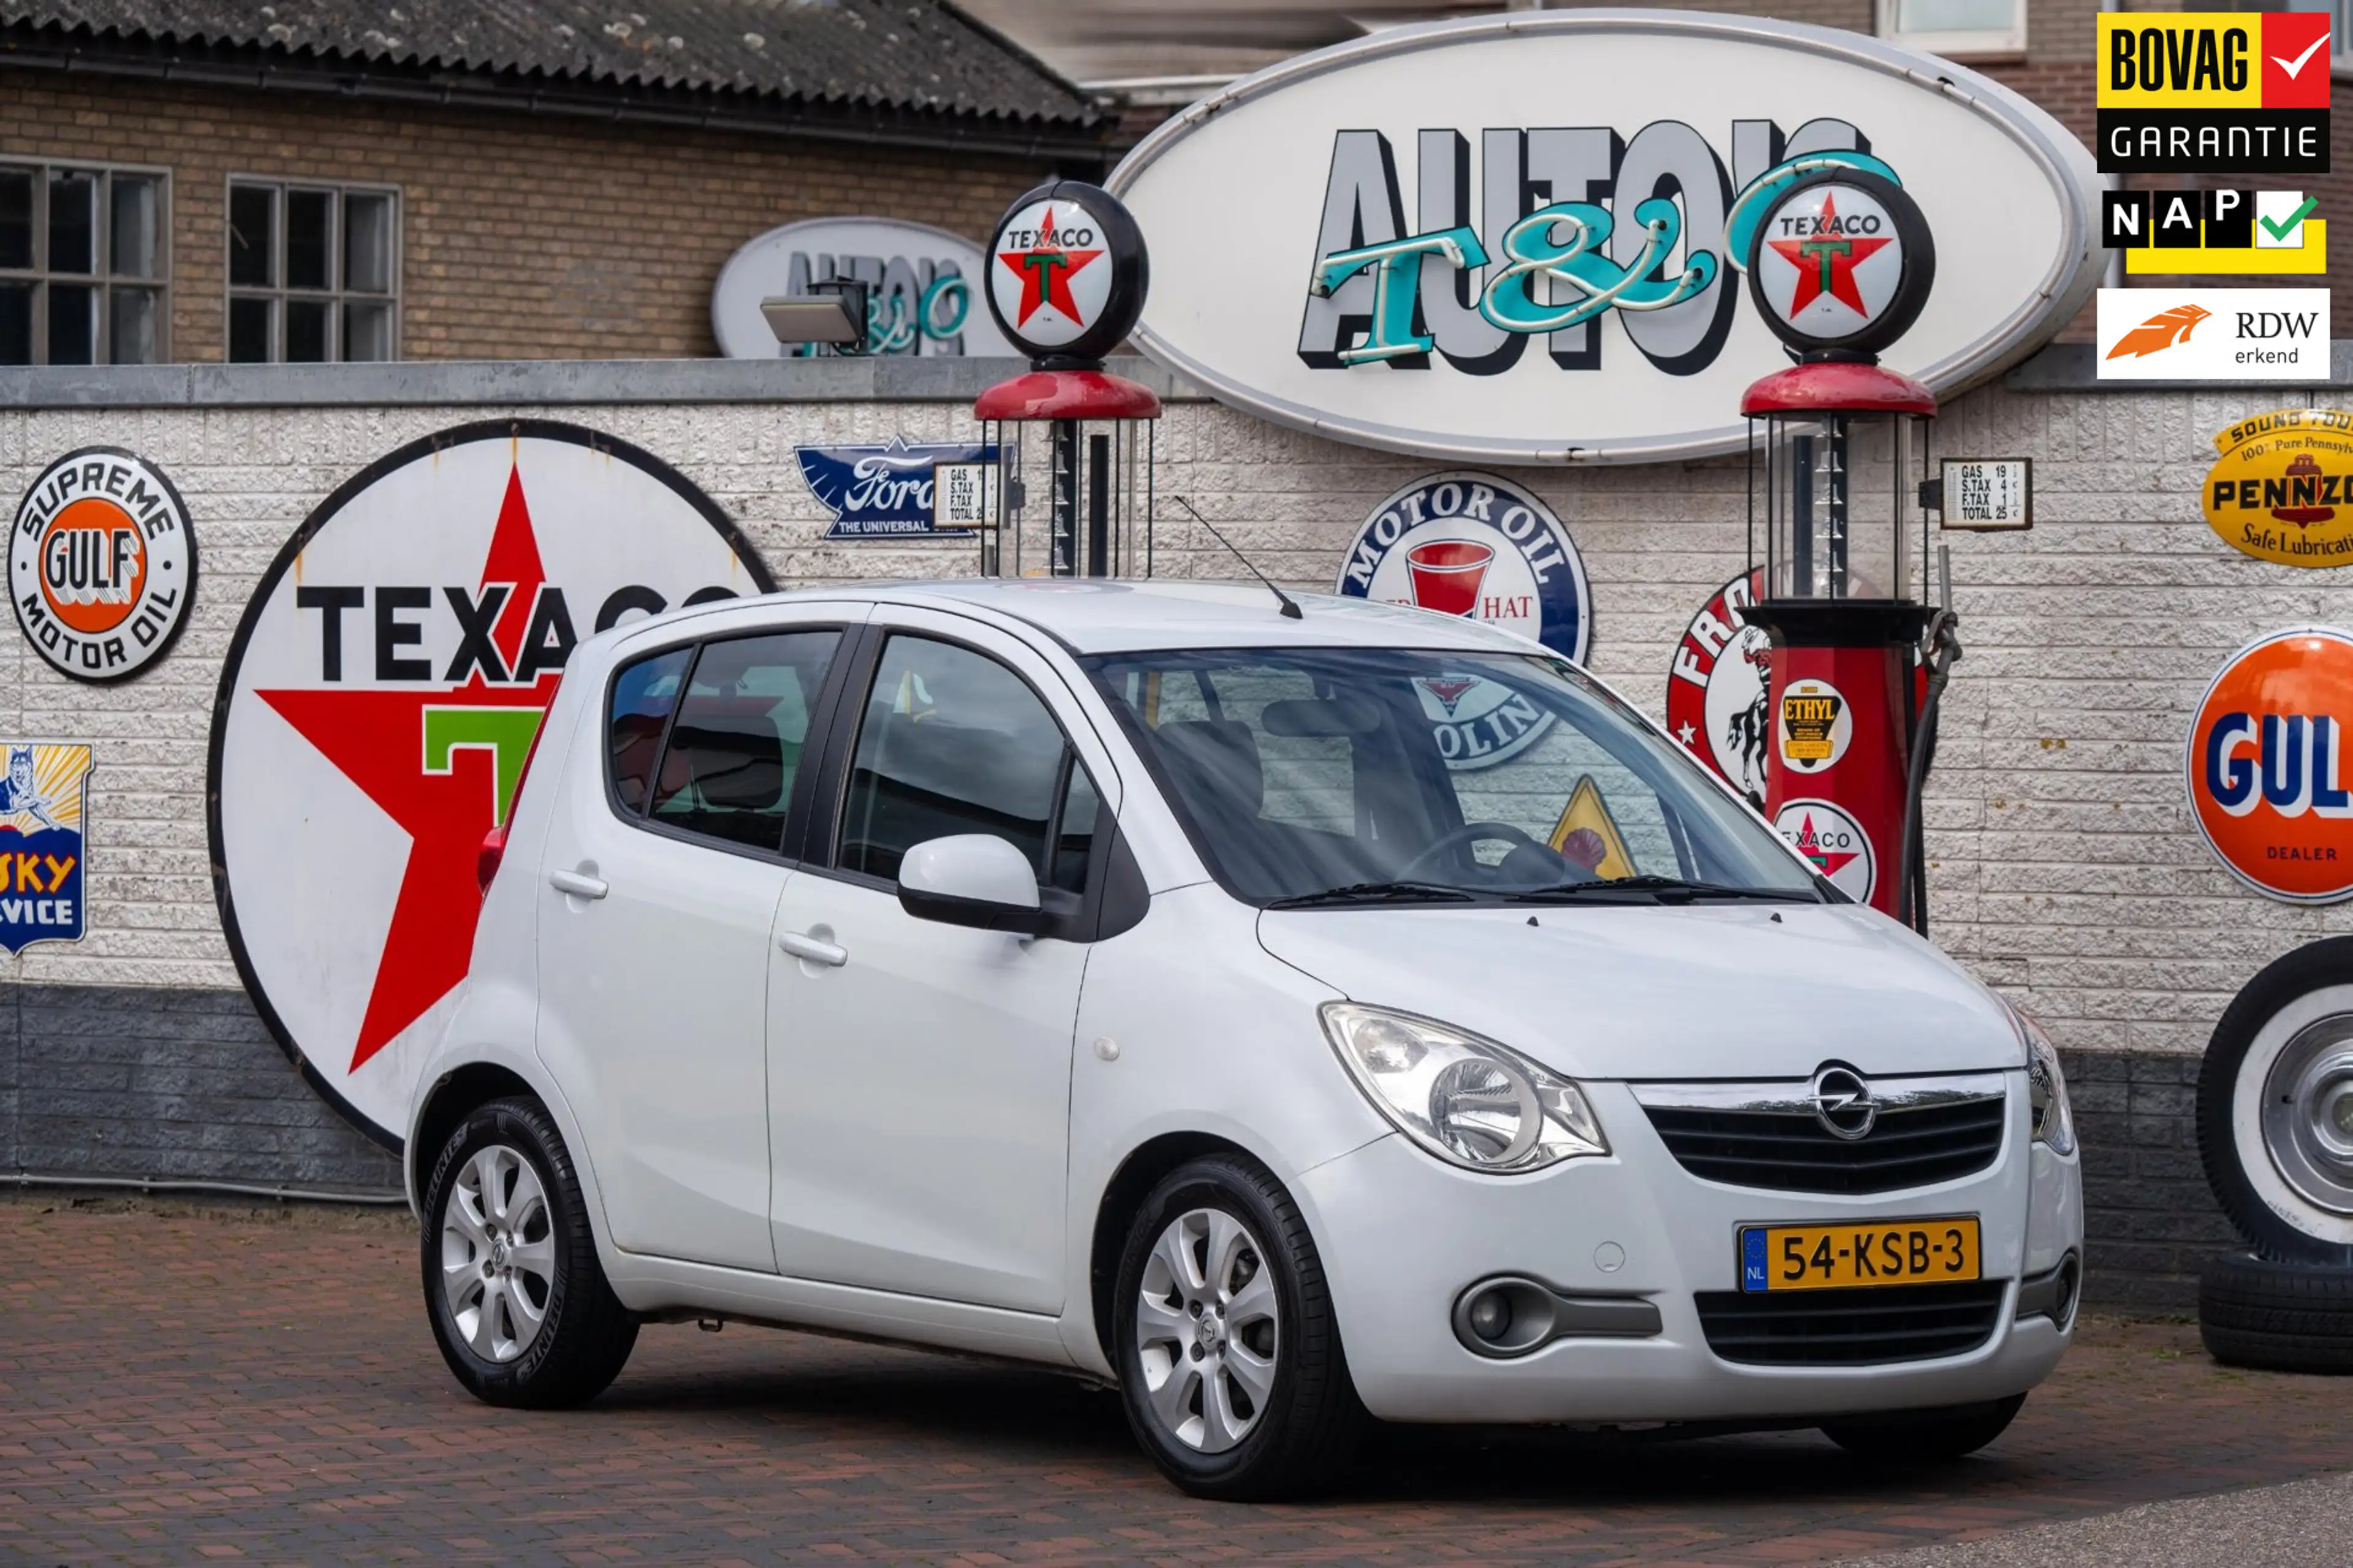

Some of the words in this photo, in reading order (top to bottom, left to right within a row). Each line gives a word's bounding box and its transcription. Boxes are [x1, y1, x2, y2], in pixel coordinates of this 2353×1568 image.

[1780, 214, 1881, 236] TEXACO
[1009, 228, 1093, 249] TEXACO
[1800, 240, 1851, 294] T
[1024, 254, 1067, 303] T
[2231, 412, 2300, 443] SOUND
[2276, 439, 2302, 451] Pure
[950, 469, 967, 481] GAS
[1961, 465, 1982, 478] GAS
[1996, 465, 2006, 478] 19
[950, 482, 974, 494] S.TAX
[1961, 479, 1991, 492] S.TAX
[2001, 479, 2007, 491] 4
[22, 462, 174, 542] SUPREME
[950, 495, 972, 507] F.TAX
[1962, 493, 1990, 506] F.TAX
[950, 507, 974, 520] TOTAL
[1962, 507, 1992, 520] TOTAL
[1996, 507, 2007, 520] 25
[839, 521, 861, 533] THE
[863, 521, 929, 533] UNIVERSAL
[1347, 483, 1496, 589] MOTOR
[1501, 506, 1565, 585] OIL
[2240, 522, 2276, 550] Safe
[46, 529, 132, 590] GULF
[1483, 596, 1533, 619] HAT
[22, 593, 127, 669] MOTOR
[131, 588, 176, 648] OIL
[297, 585, 741, 682] TEXA
[1785, 699, 1835, 720] ETHYL
[2207, 711, 2350, 809] GUL
[2268, 846, 2337, 861] DEALER
[0, 898, 72, 924] VICE
[1783, 1229, 1965, 1281] 54-KSB-3
[1747, 1267, 1764, 1281] NL
